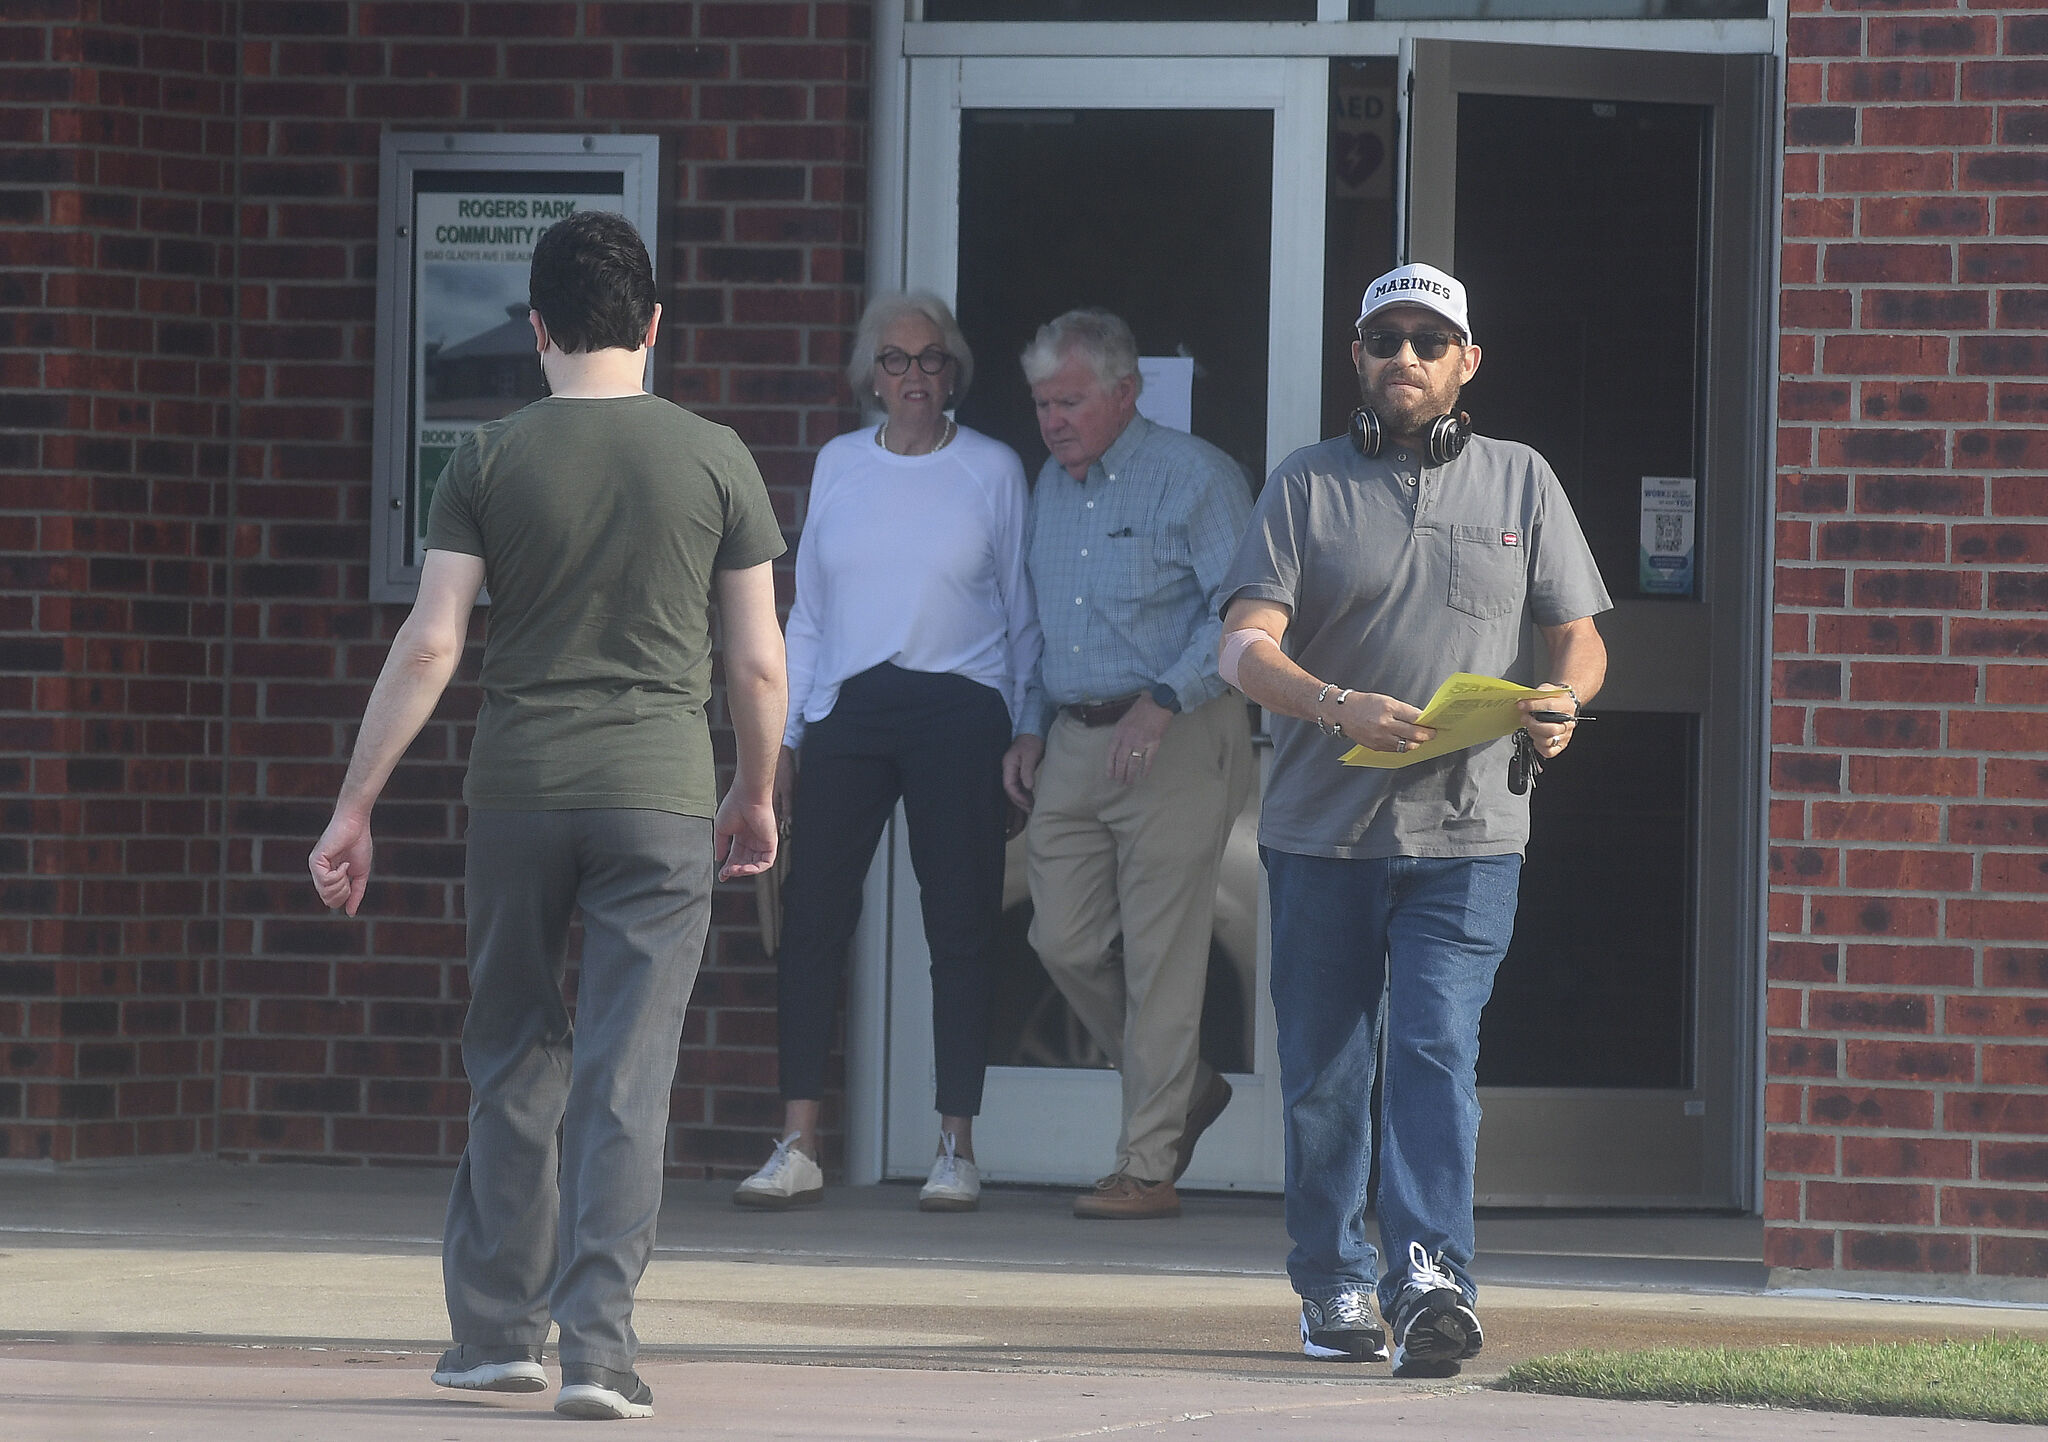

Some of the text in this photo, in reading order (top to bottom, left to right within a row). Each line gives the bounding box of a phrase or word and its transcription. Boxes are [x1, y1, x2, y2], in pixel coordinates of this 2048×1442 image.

[458, 200, 576, 218] ROGERS PARK
[436, 226, 533, 243] COMMUNITY
[1374, 278, 1450, 299] MARINES
[422, 430, 456, 443] BOOK
